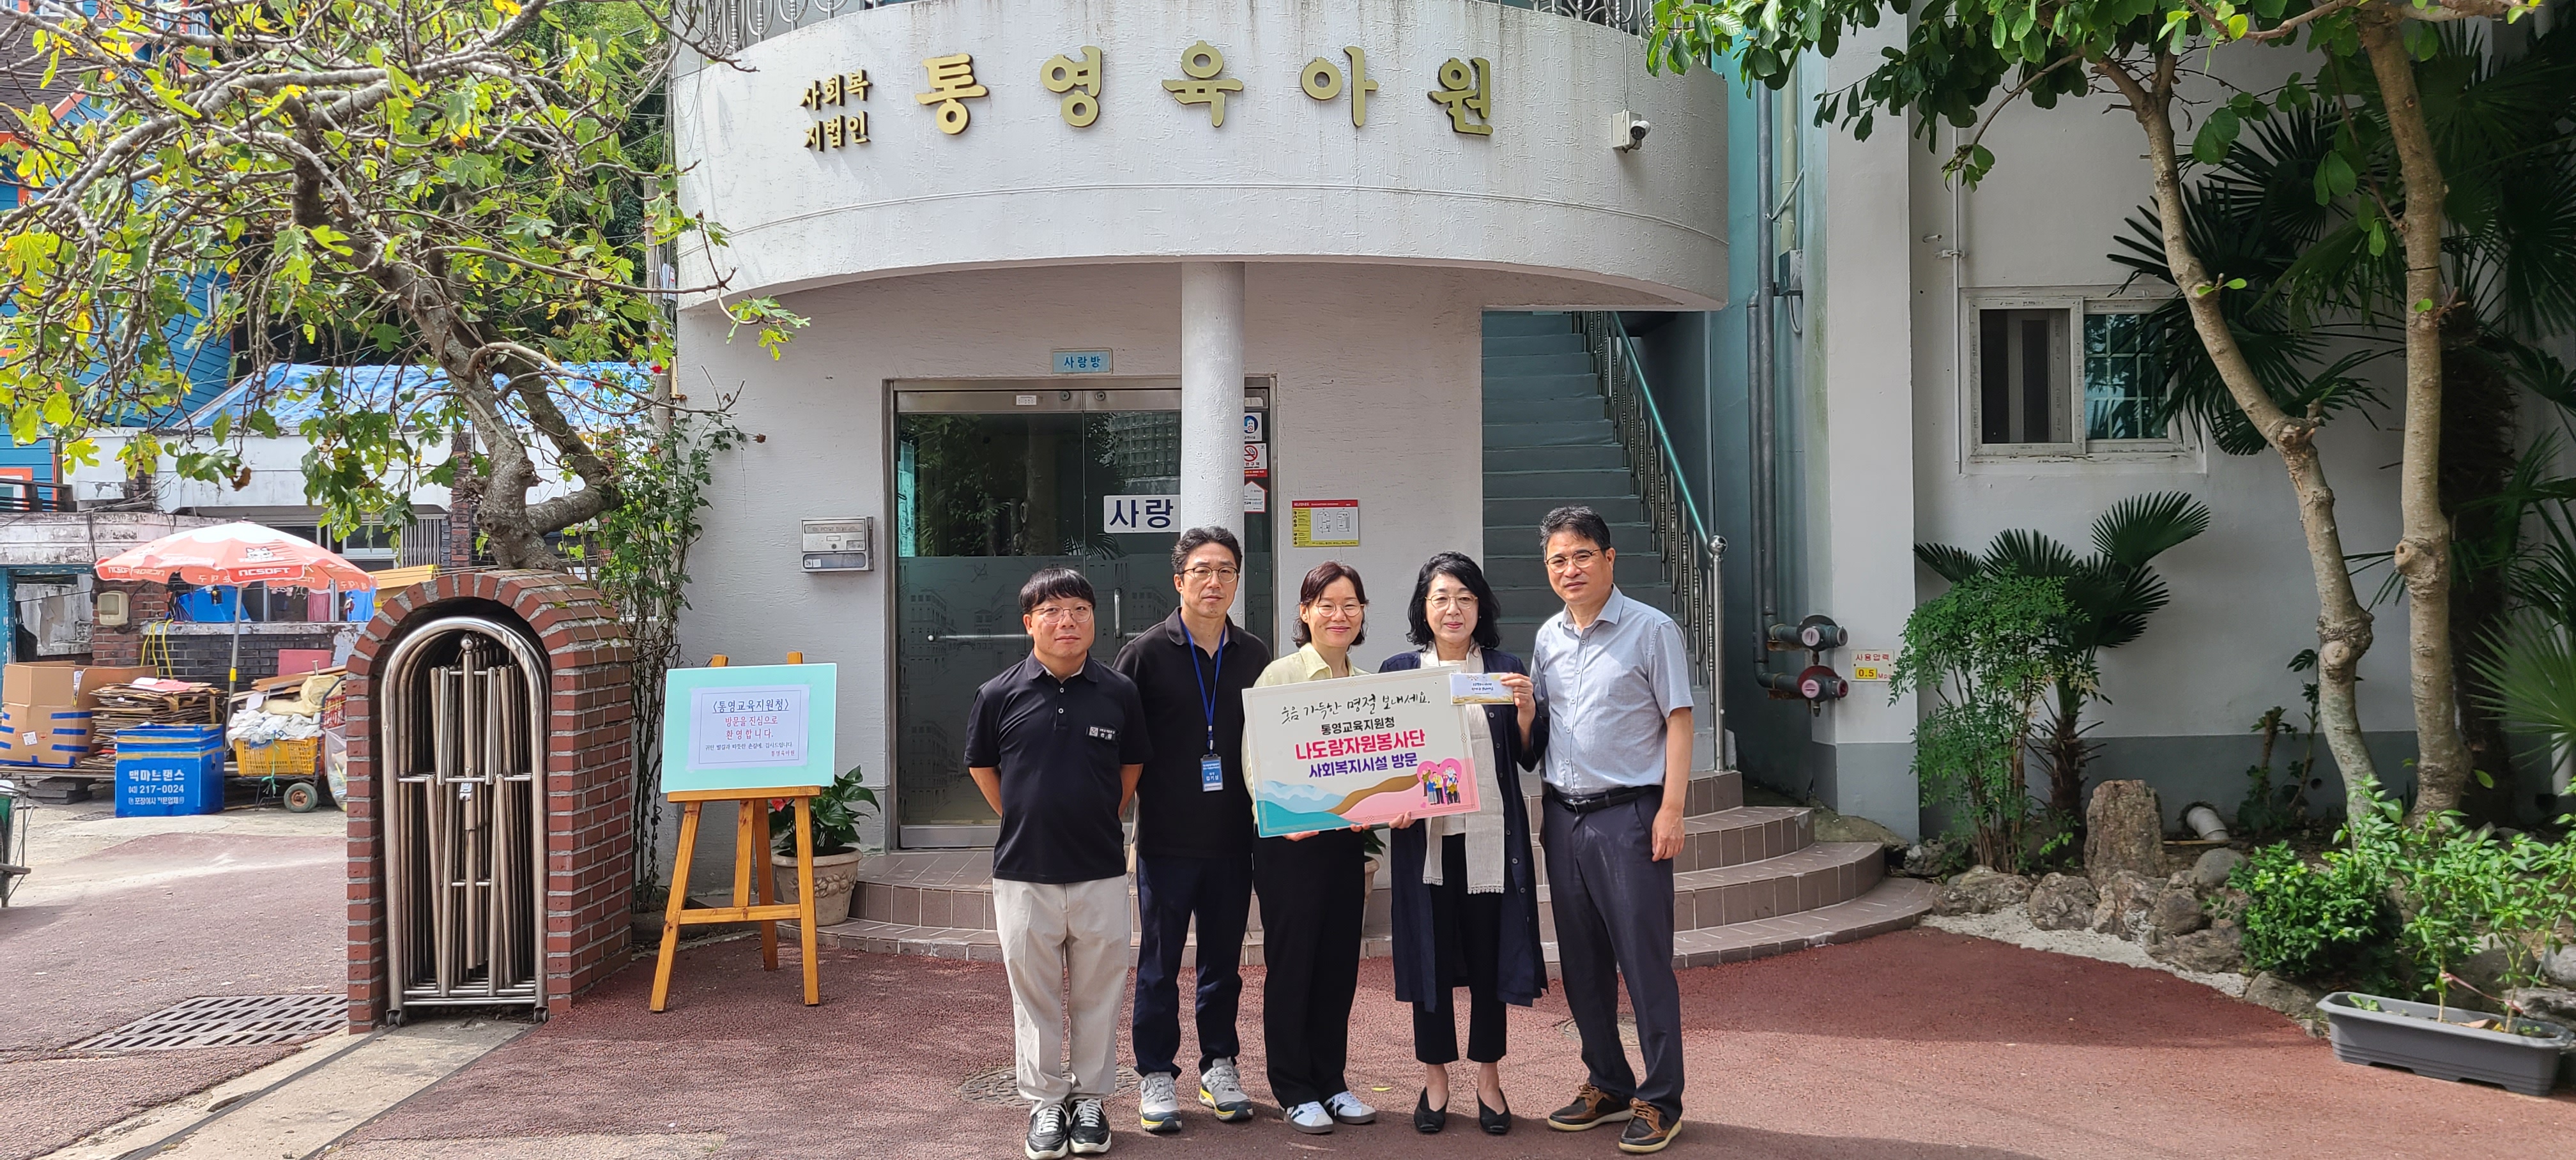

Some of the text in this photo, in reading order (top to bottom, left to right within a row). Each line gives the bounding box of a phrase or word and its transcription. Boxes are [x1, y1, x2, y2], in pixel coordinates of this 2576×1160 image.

[799, 69, 873, 111] 사회복
[915, 40, 1494, 136] 통영육아원
[803, 110, 871, 152] 지법인
[1064, 356, 1101, 369] 사랑방
[1109, 499, 1174, 528] 사랑
[238, 567, 291, 576] NCSOFT
[1282, 691, 1430, 724] 웃음 가득한 명절 보내세요.
[725, 715, 778, 727] 방문을 진심으로
[1321, 716, 1395, 735] 통영교육지원청
[1295, 729, 1425, 759] 나도람자원봉사단
[1309, 752, 1418, 778] 사회복지시설 방문
[135, 797, 157, 805] 포장이사
[139, 784, 184, 793] 217-0024
